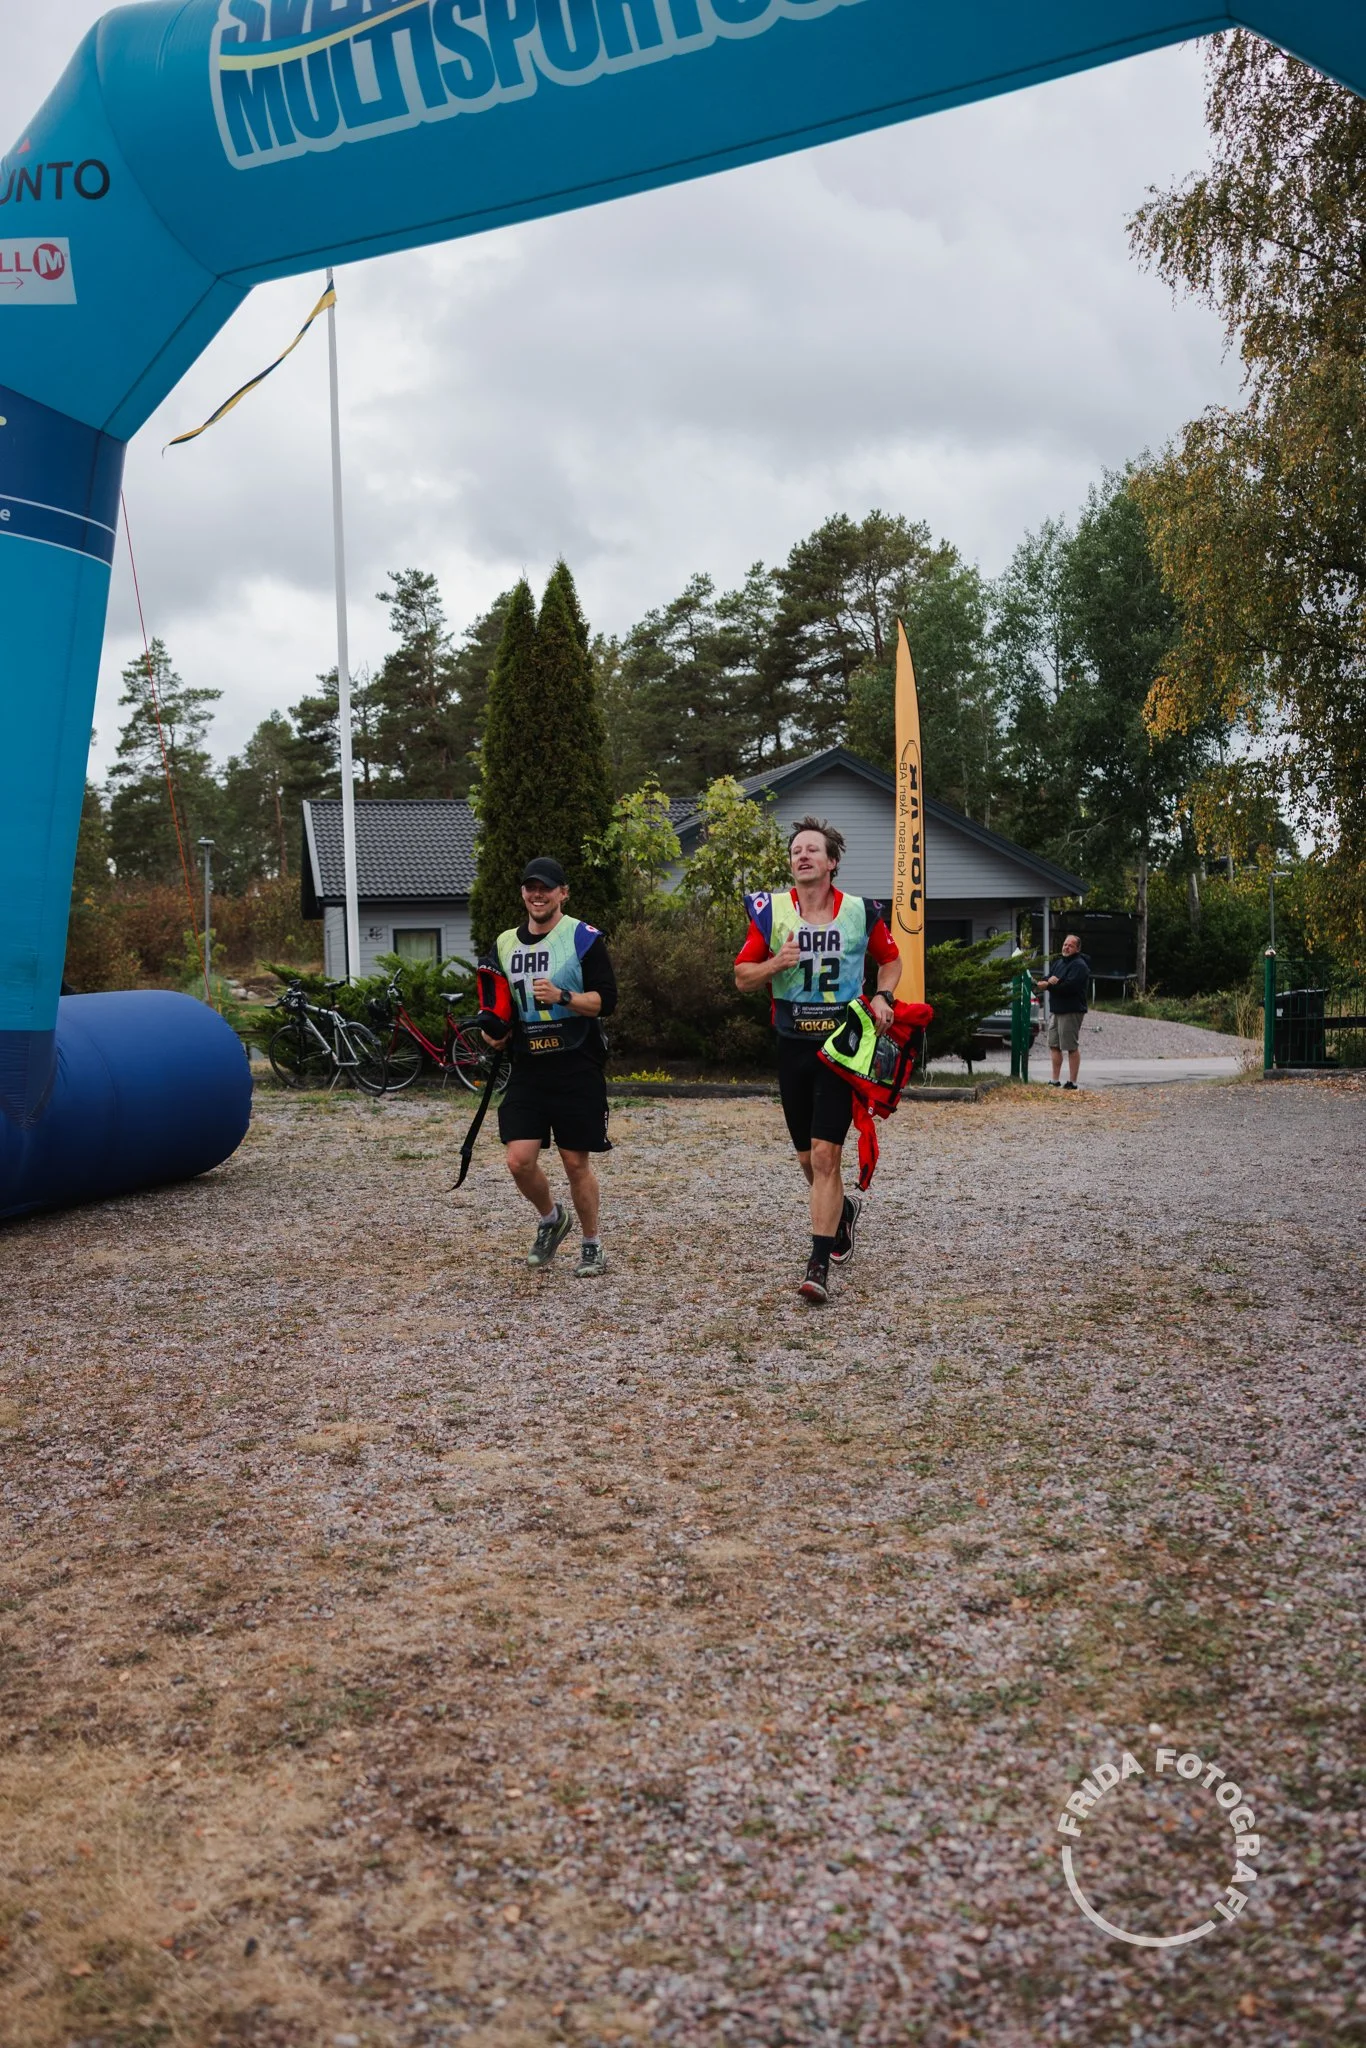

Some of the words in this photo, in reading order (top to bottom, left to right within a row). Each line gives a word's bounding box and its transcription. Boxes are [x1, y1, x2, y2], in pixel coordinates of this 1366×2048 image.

[798, 927, 841, 952] ÖAR
[511, 950, 549, 974] ÖAR
[799, 957, 840, 992] 12
[799, 1020, 836, 1032] JOKAB
